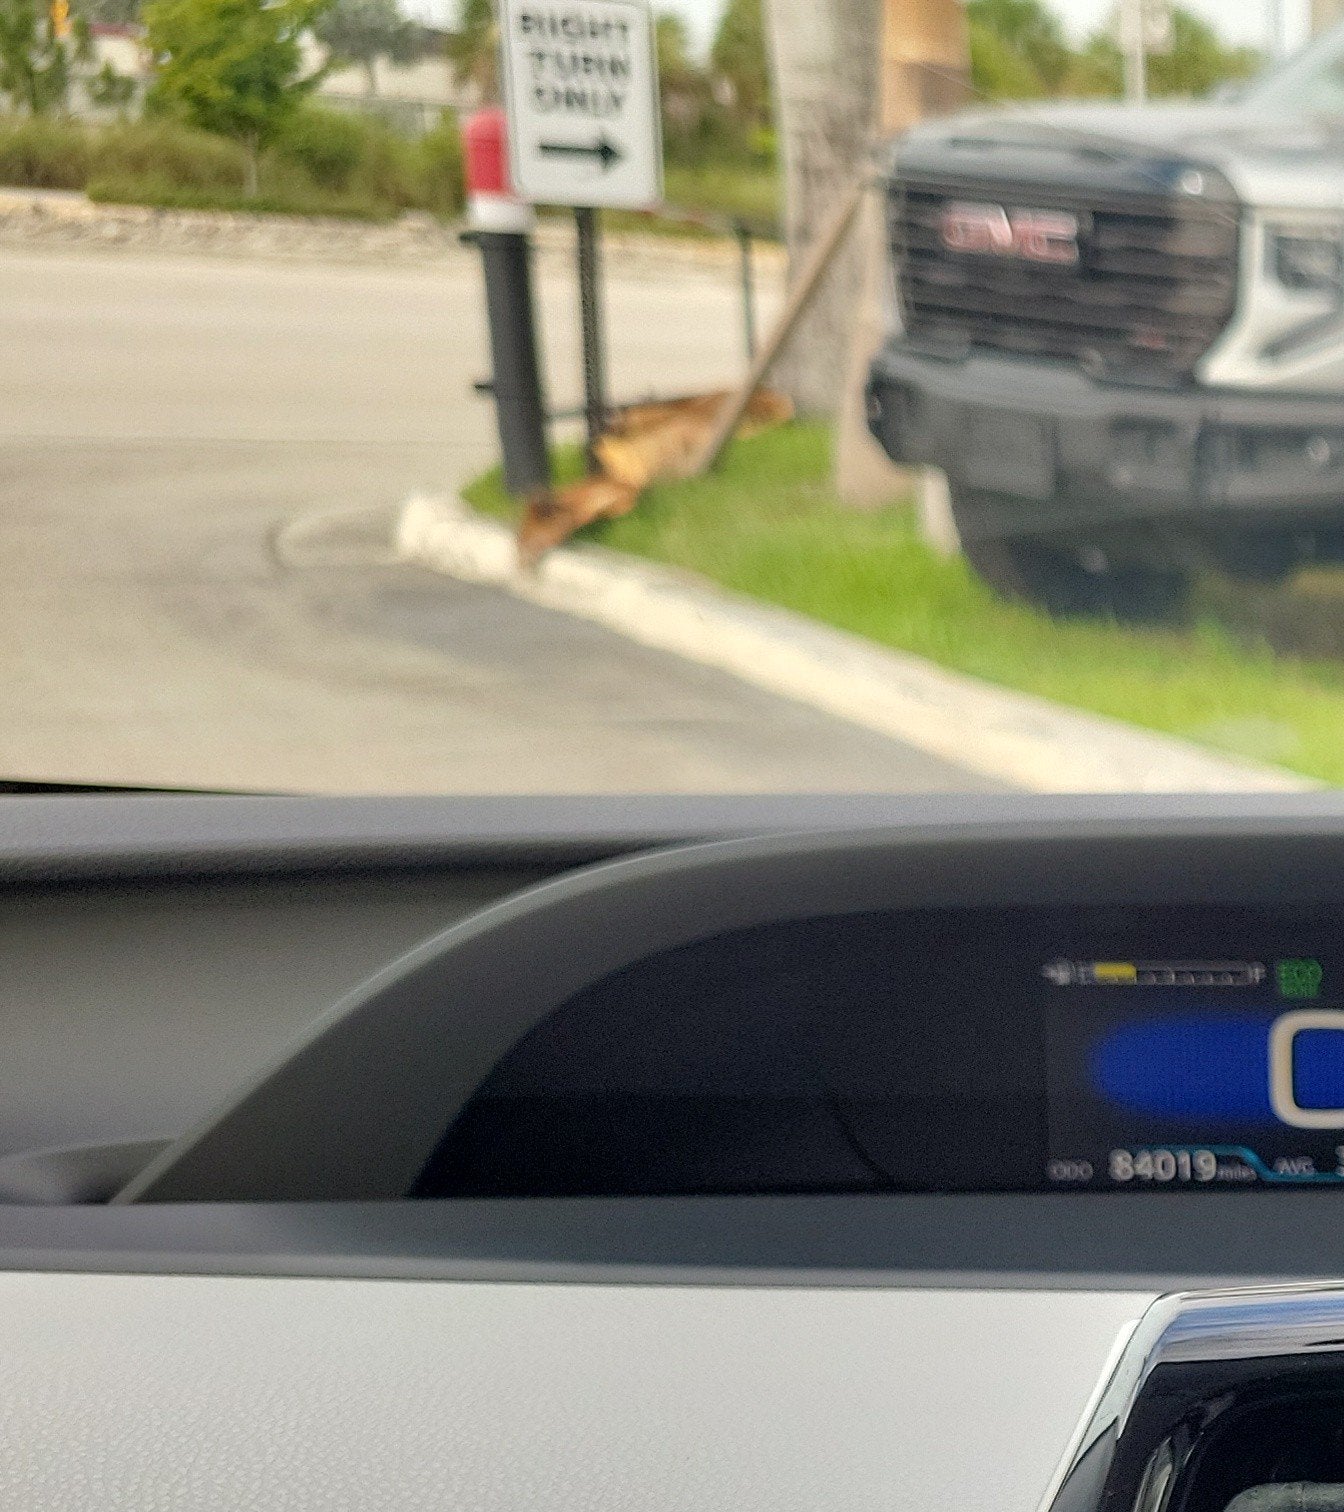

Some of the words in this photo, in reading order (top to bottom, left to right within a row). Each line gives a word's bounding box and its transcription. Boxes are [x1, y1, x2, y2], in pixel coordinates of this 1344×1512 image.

[520, 12, 630, 38] RIGHT
[529, 50, 630, 76] TURN
[533, 84, 626, 112] ONLY
[944, 204, 1078, 264] GMC
[1108, 1149, 1217, 1182] 84019
